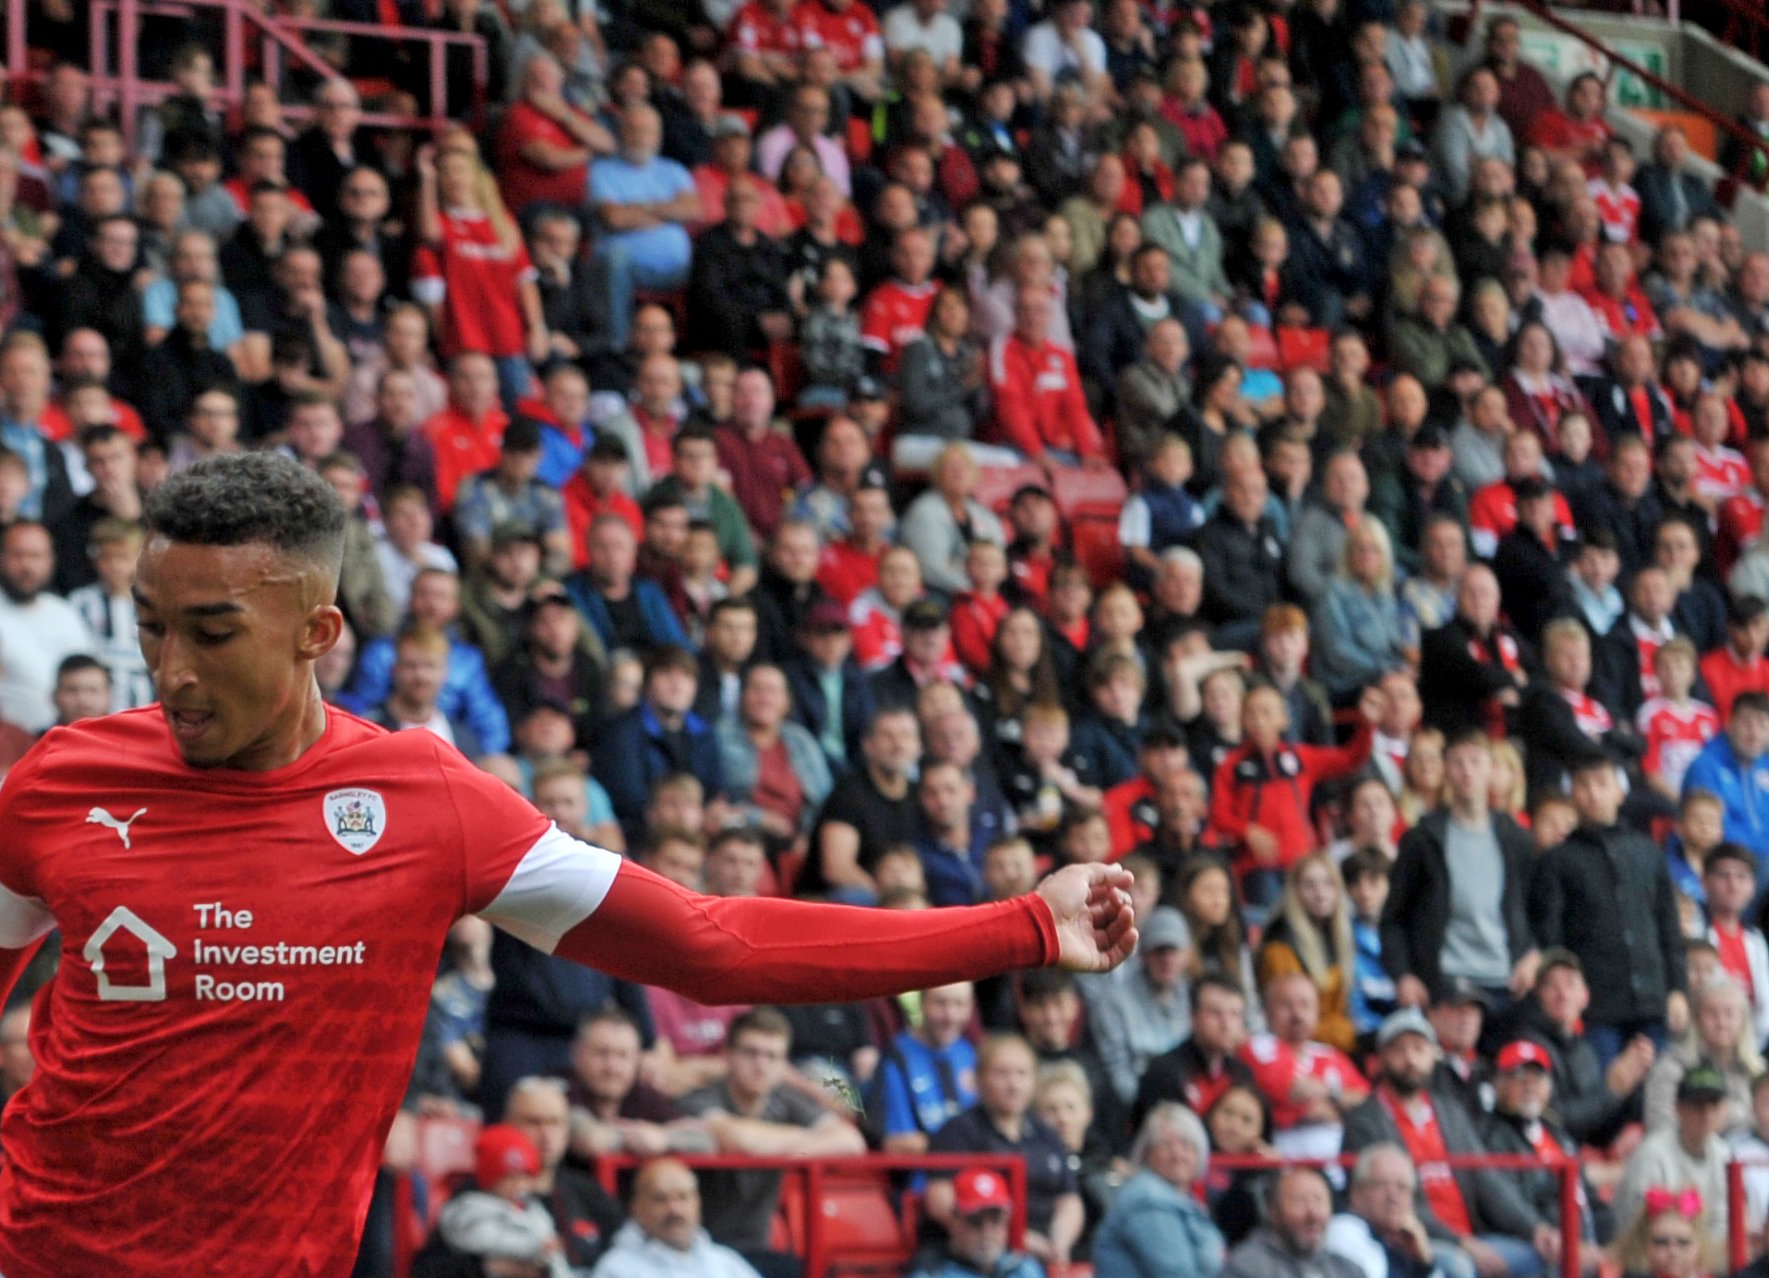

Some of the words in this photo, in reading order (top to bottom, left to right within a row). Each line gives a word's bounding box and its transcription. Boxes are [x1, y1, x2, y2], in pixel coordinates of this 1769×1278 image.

[193, 901, 253, 929] The
[194, 938, 366, 965] Investment
[195, 974, 285, 1001] Room
